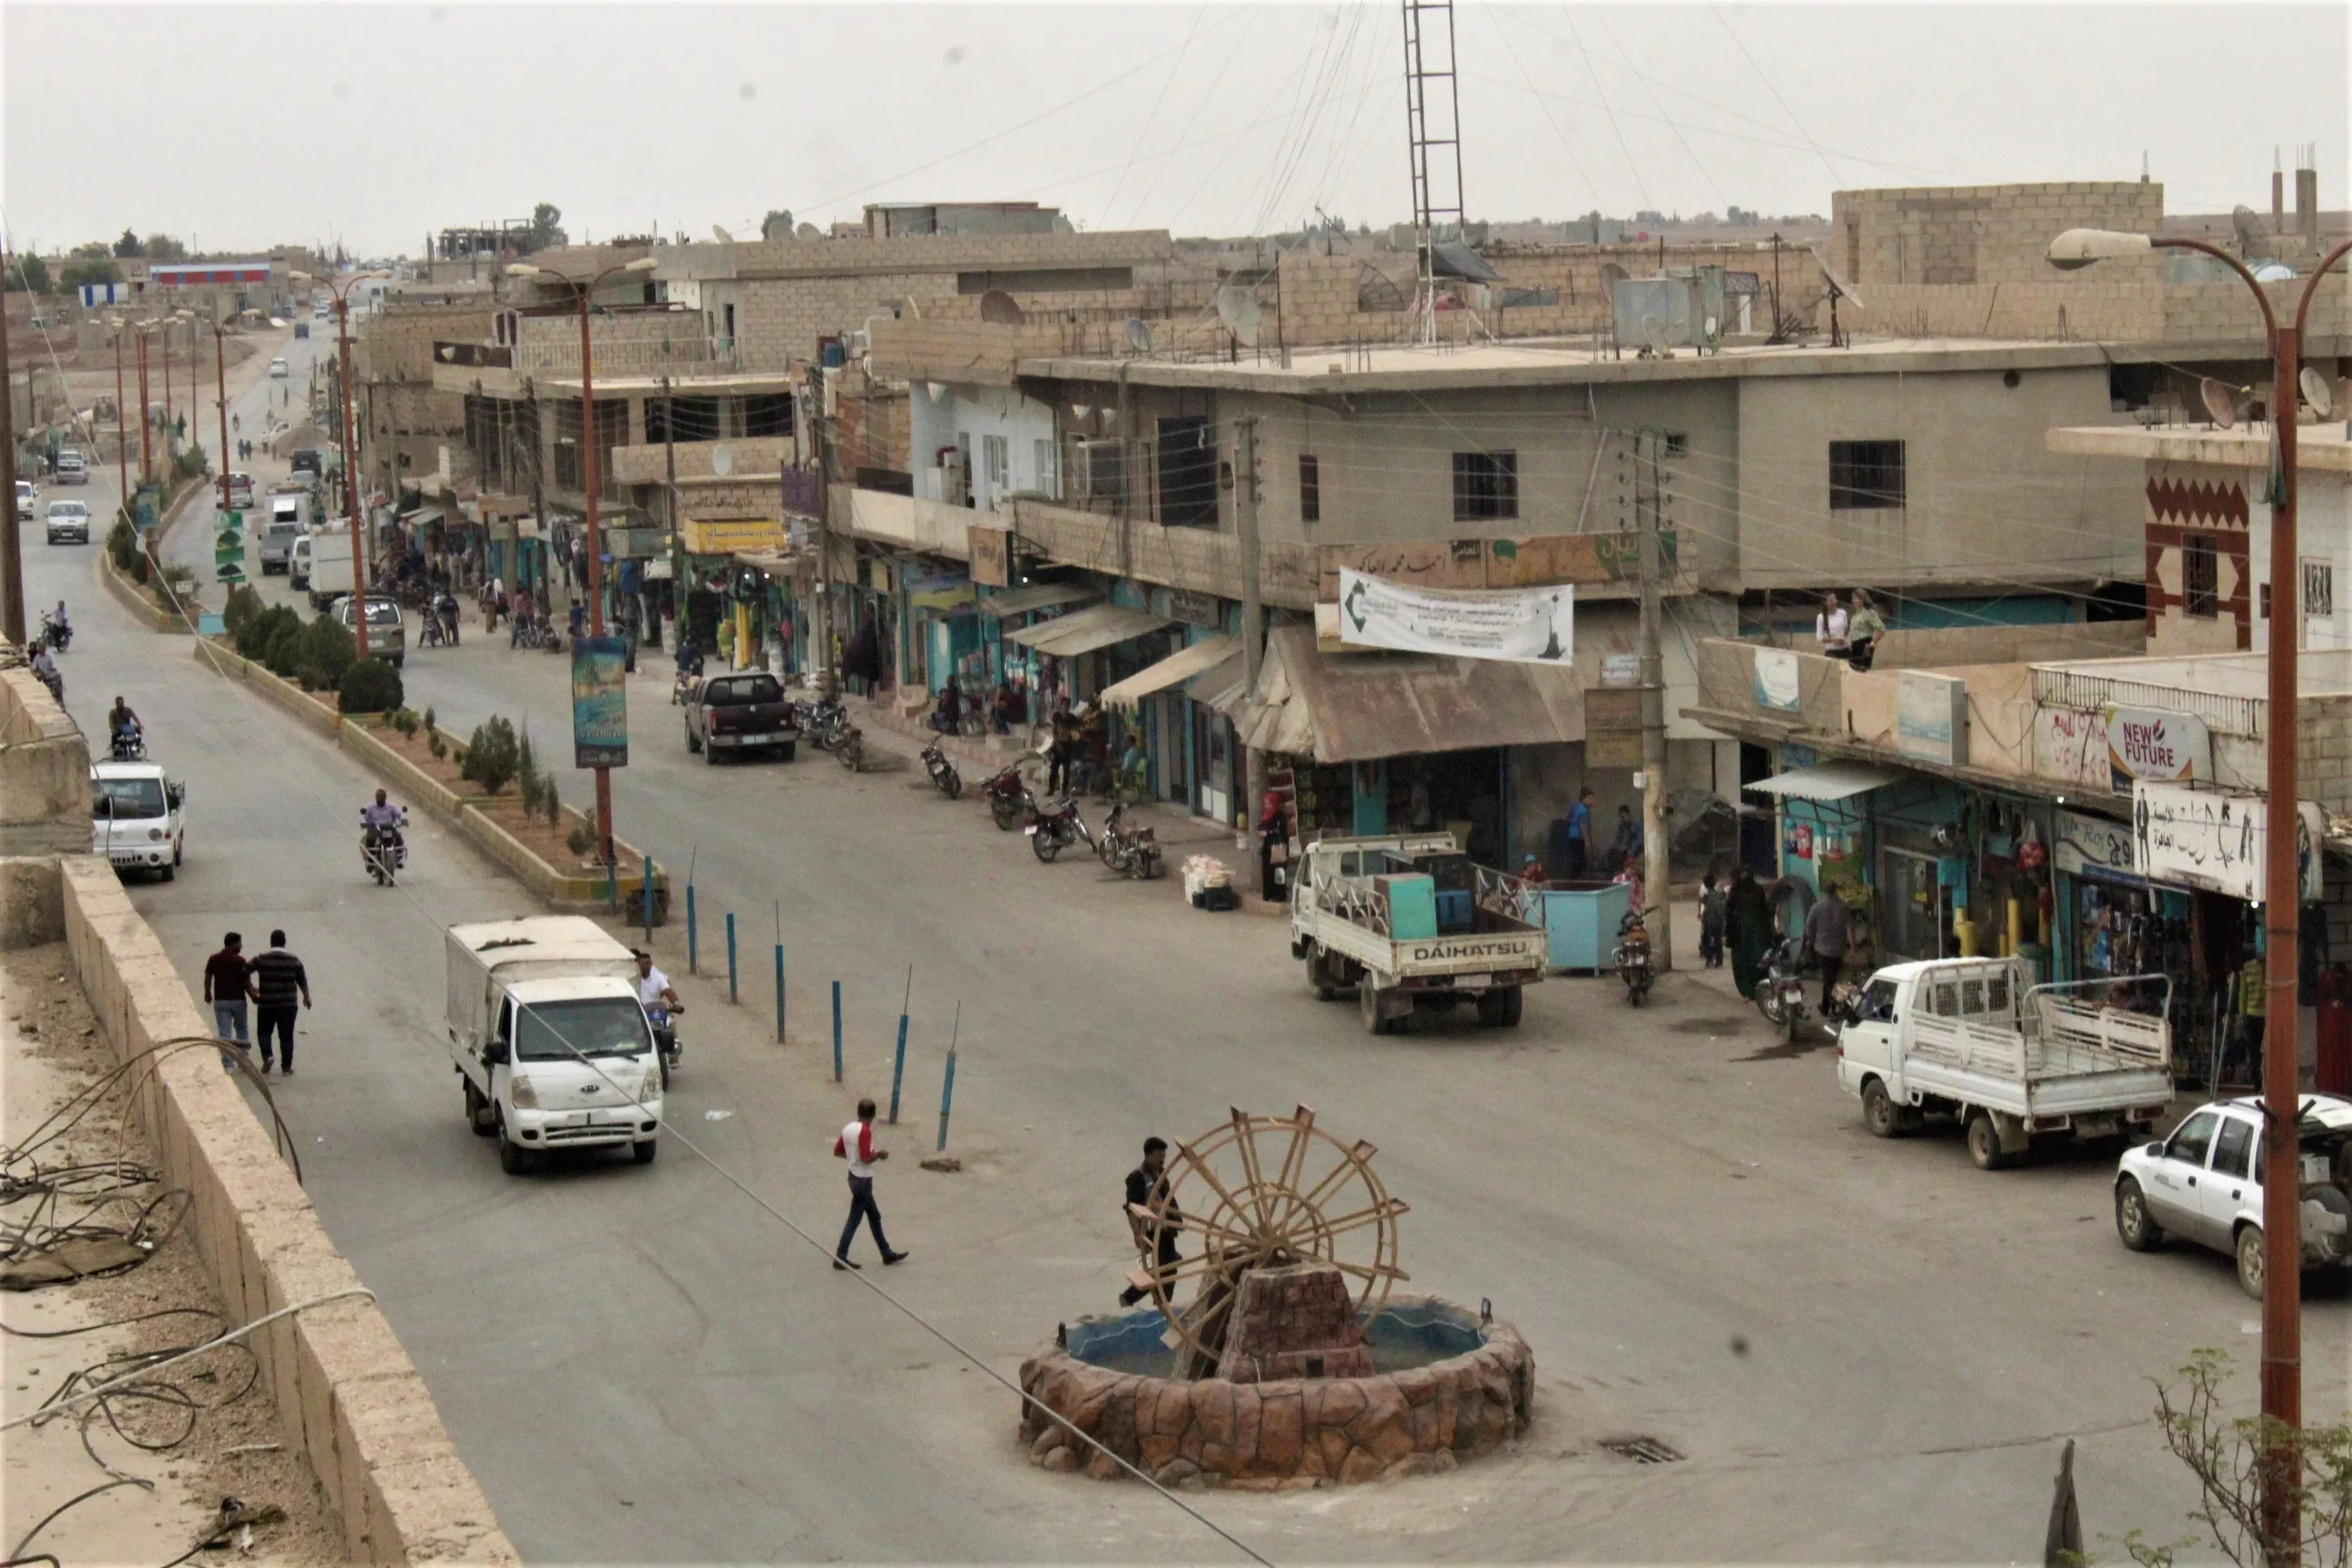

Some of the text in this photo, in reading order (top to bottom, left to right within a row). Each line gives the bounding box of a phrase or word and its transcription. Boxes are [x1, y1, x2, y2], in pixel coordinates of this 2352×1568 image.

[2122, 721, 2152, 744] NEW
[2126, 744, 2175, 768] FUTURE
[1414, 941, 1527, 961] DAIHATSU
